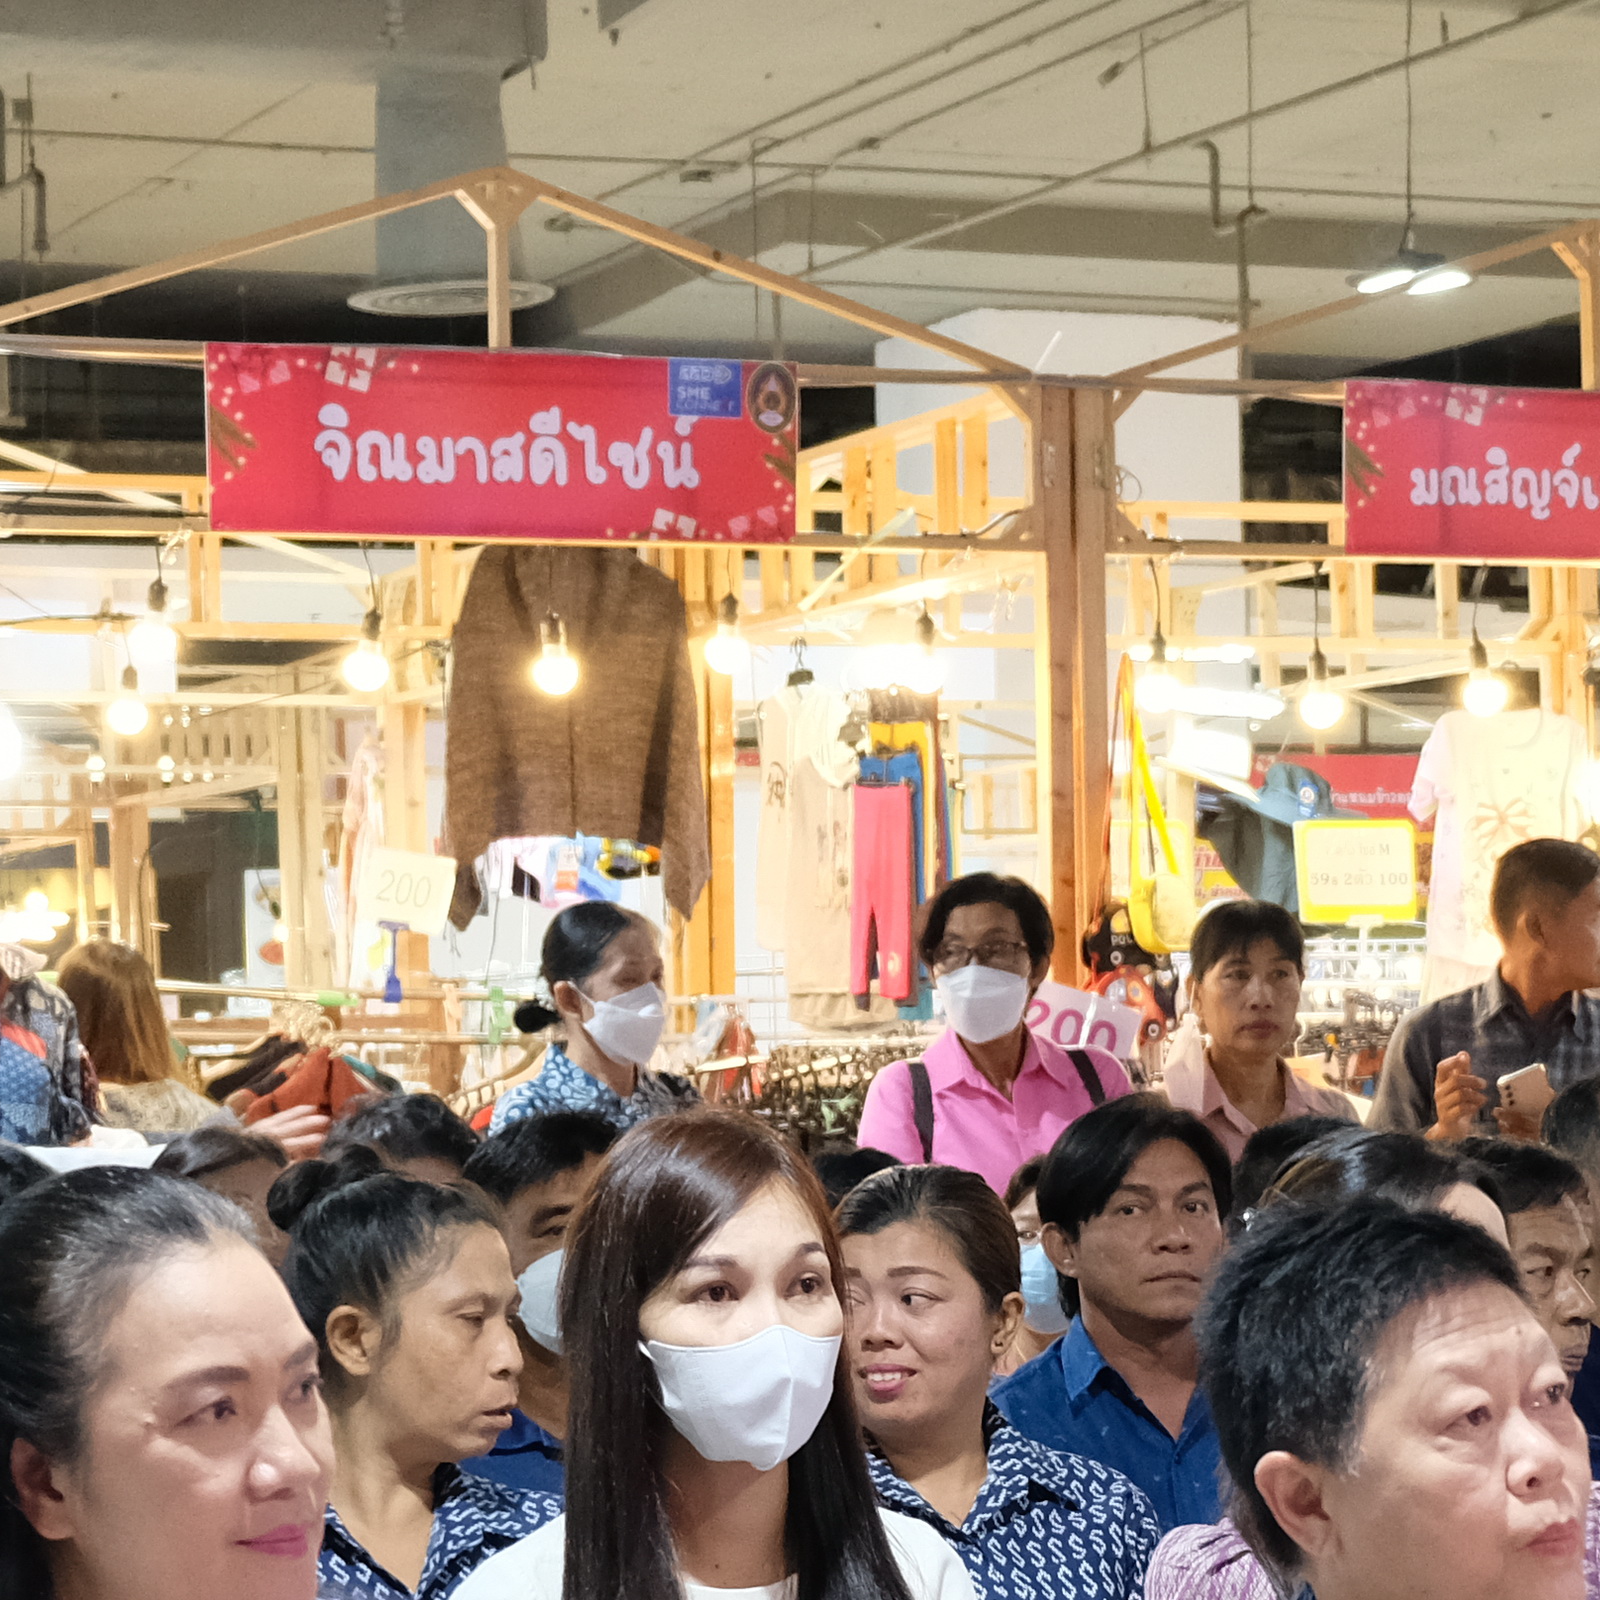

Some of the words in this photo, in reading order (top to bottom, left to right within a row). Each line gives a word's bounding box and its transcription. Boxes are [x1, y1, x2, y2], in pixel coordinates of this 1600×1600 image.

[676, 386, 711, 400] SME
[1380, 872, 1408, 886] 100
[375, 869, 432, 909] 200
